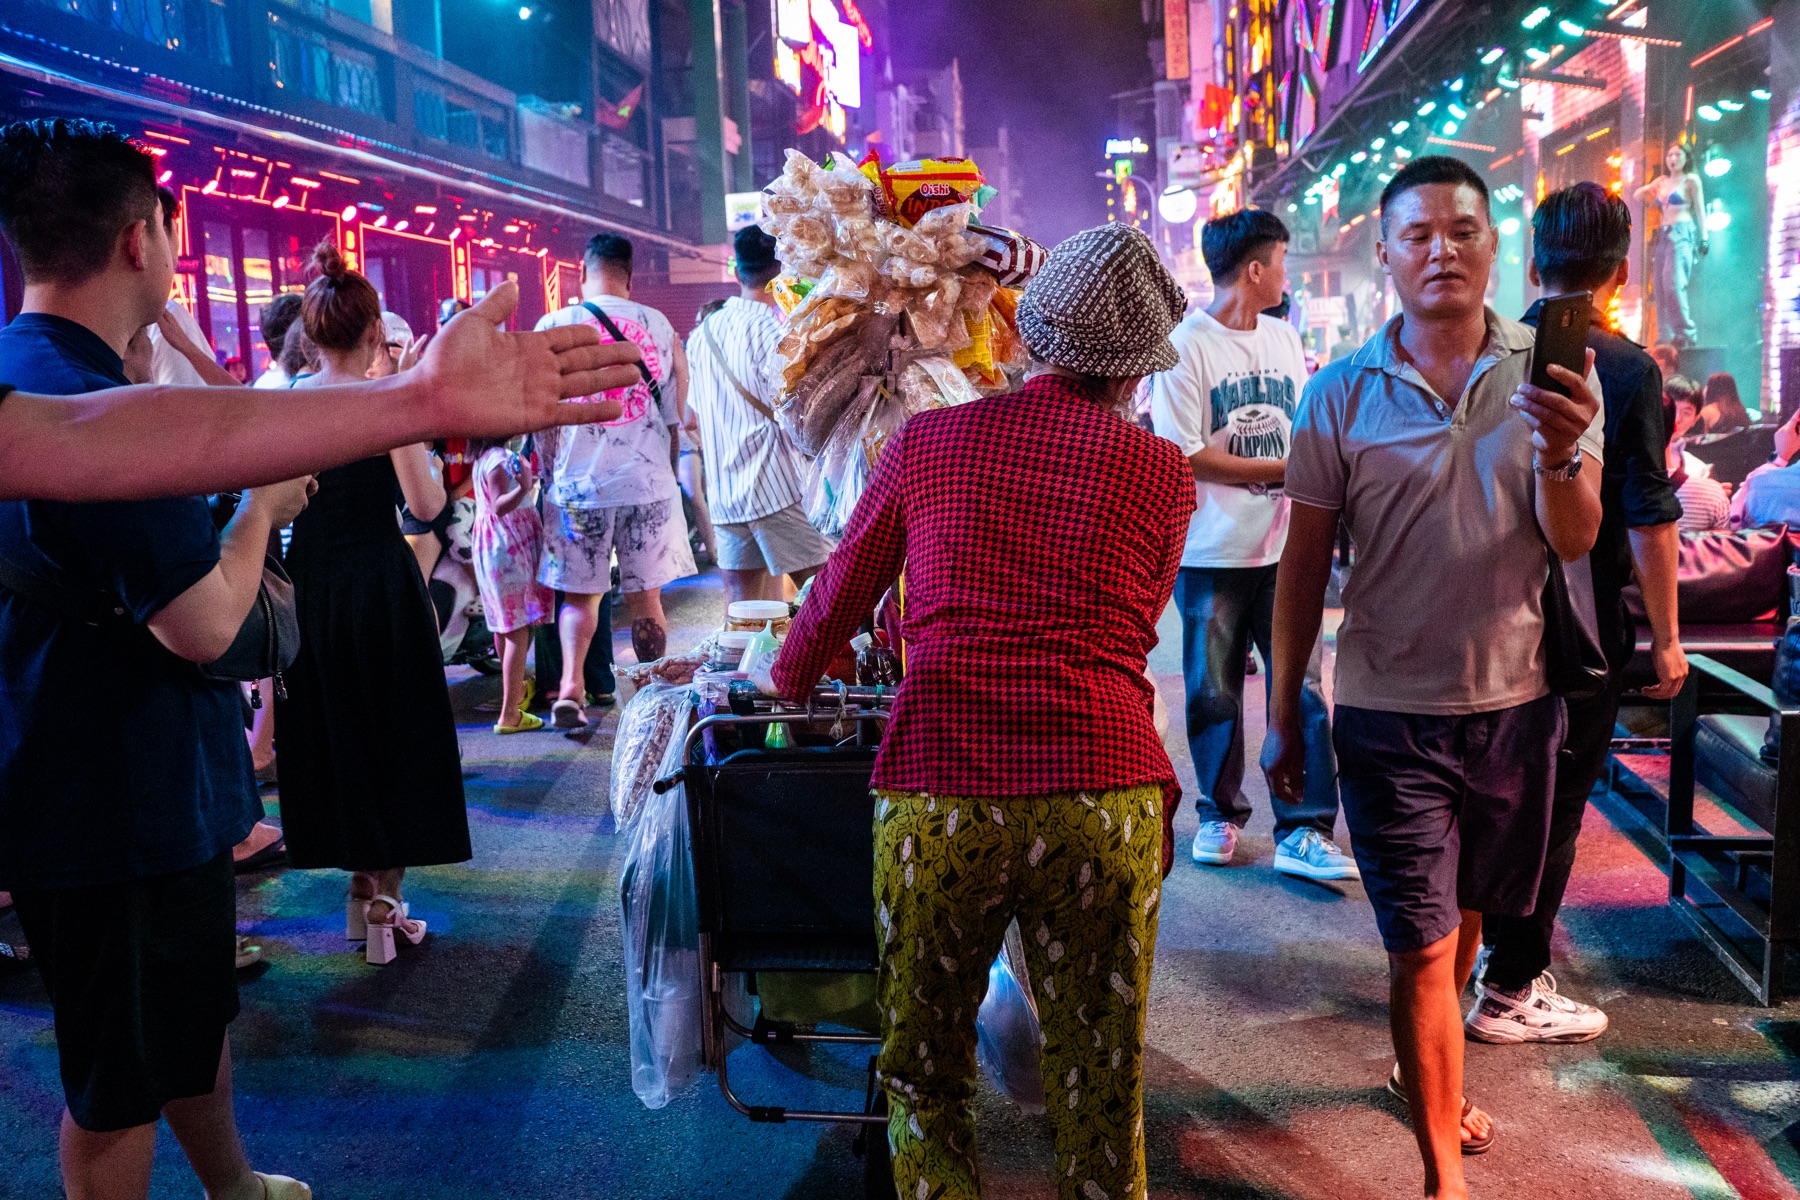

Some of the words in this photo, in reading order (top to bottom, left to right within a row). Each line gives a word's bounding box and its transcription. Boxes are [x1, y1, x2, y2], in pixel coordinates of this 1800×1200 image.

[920, 183, 949, 195] Oishi
[1228, 368, 1278, 377] FLORIDA
[1210, 375, 1296, 435] MARLINS
[1228, 427, 1284, 459] CAMPIONS
